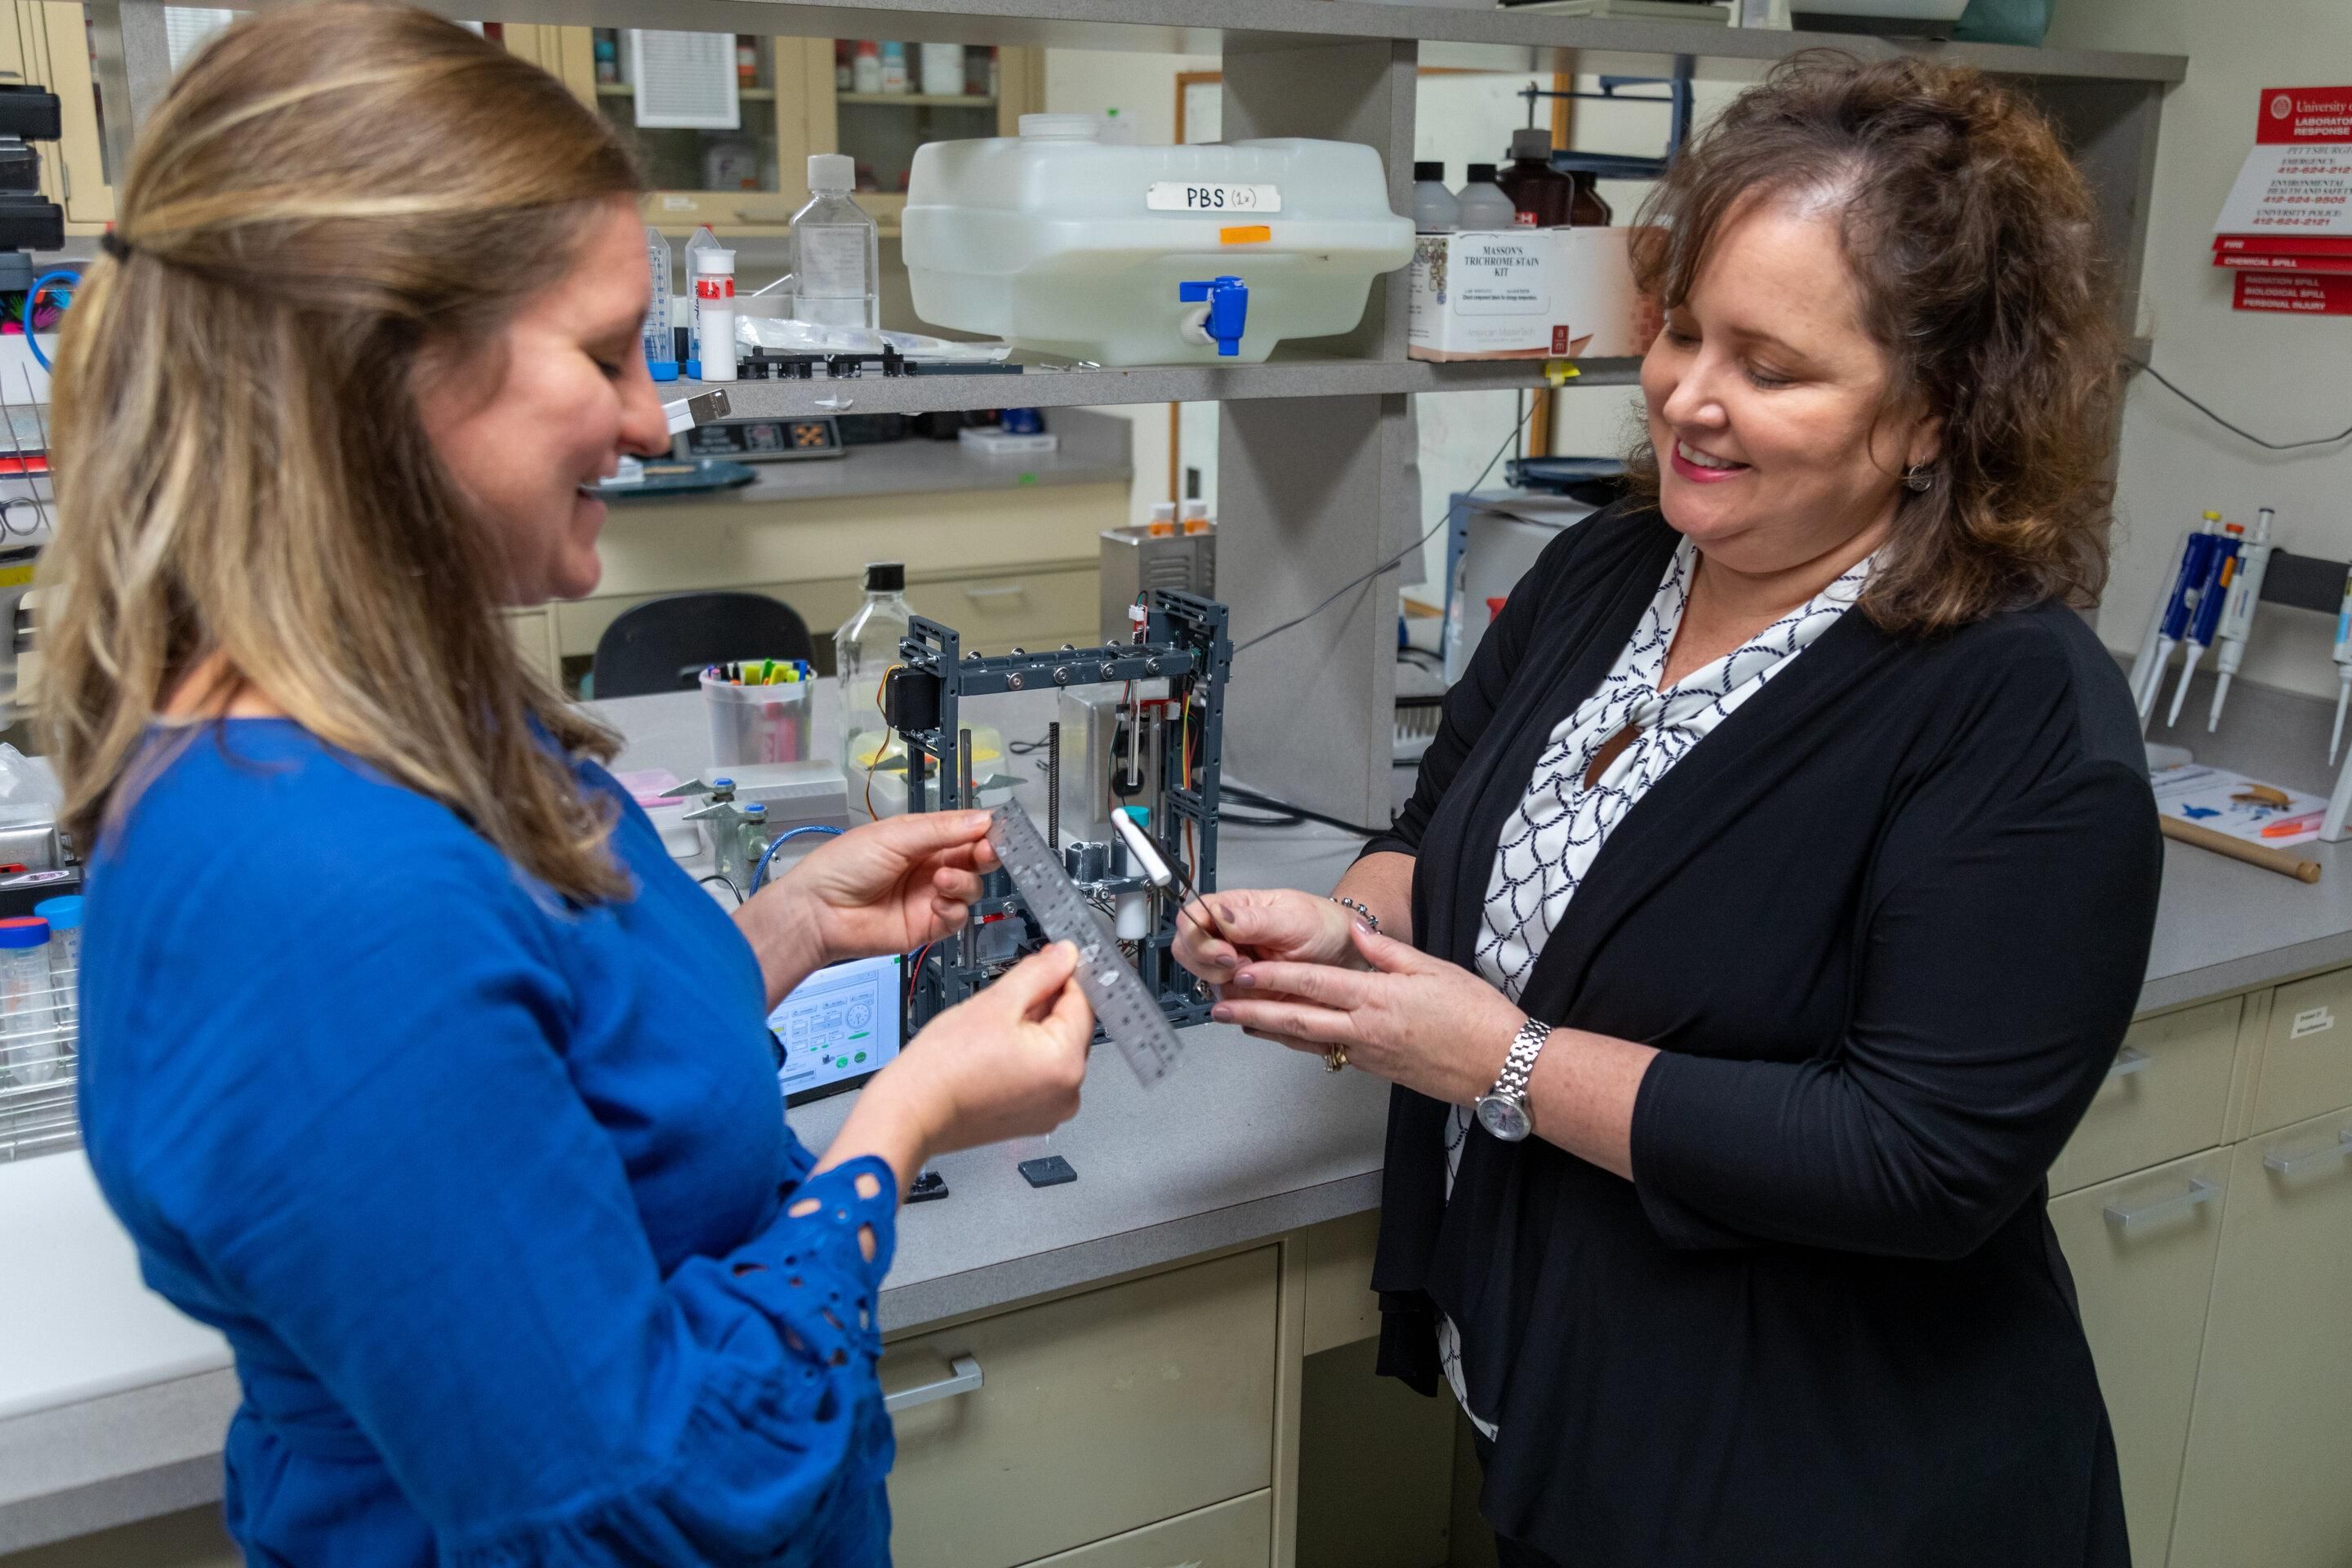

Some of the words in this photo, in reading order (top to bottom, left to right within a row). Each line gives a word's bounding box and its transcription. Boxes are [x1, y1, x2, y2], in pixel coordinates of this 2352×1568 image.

[2296, 100, 2346, 114] University
[2293, 127, 2351, 136] RESPONSE
[1187, 187, 1225, 208] PBS
[2223, 240, 2245, 249] FIRE
[1483, 246, 1523, 256] MASSON'S
[1464, 256, 1515, 266] TRICHROME
[1515, 257, 1539, 266] STAIN
[2224, 256, 2270, 266] CHEMICAL
[2271, 257, 2298, 268] SPILL
[1494, 267, 1509, 277] KIT
[2244, 287, 2298, 297] BIOLOGICAL
[2300, 290, 2326, 299] SPILL
[2243, 298, 2291, 309] PERSONAL
[2292, 301, 2326, 310] INJURY
[1557, 329, 1564, 338] a
[1556, 343, 1565, 351] m
